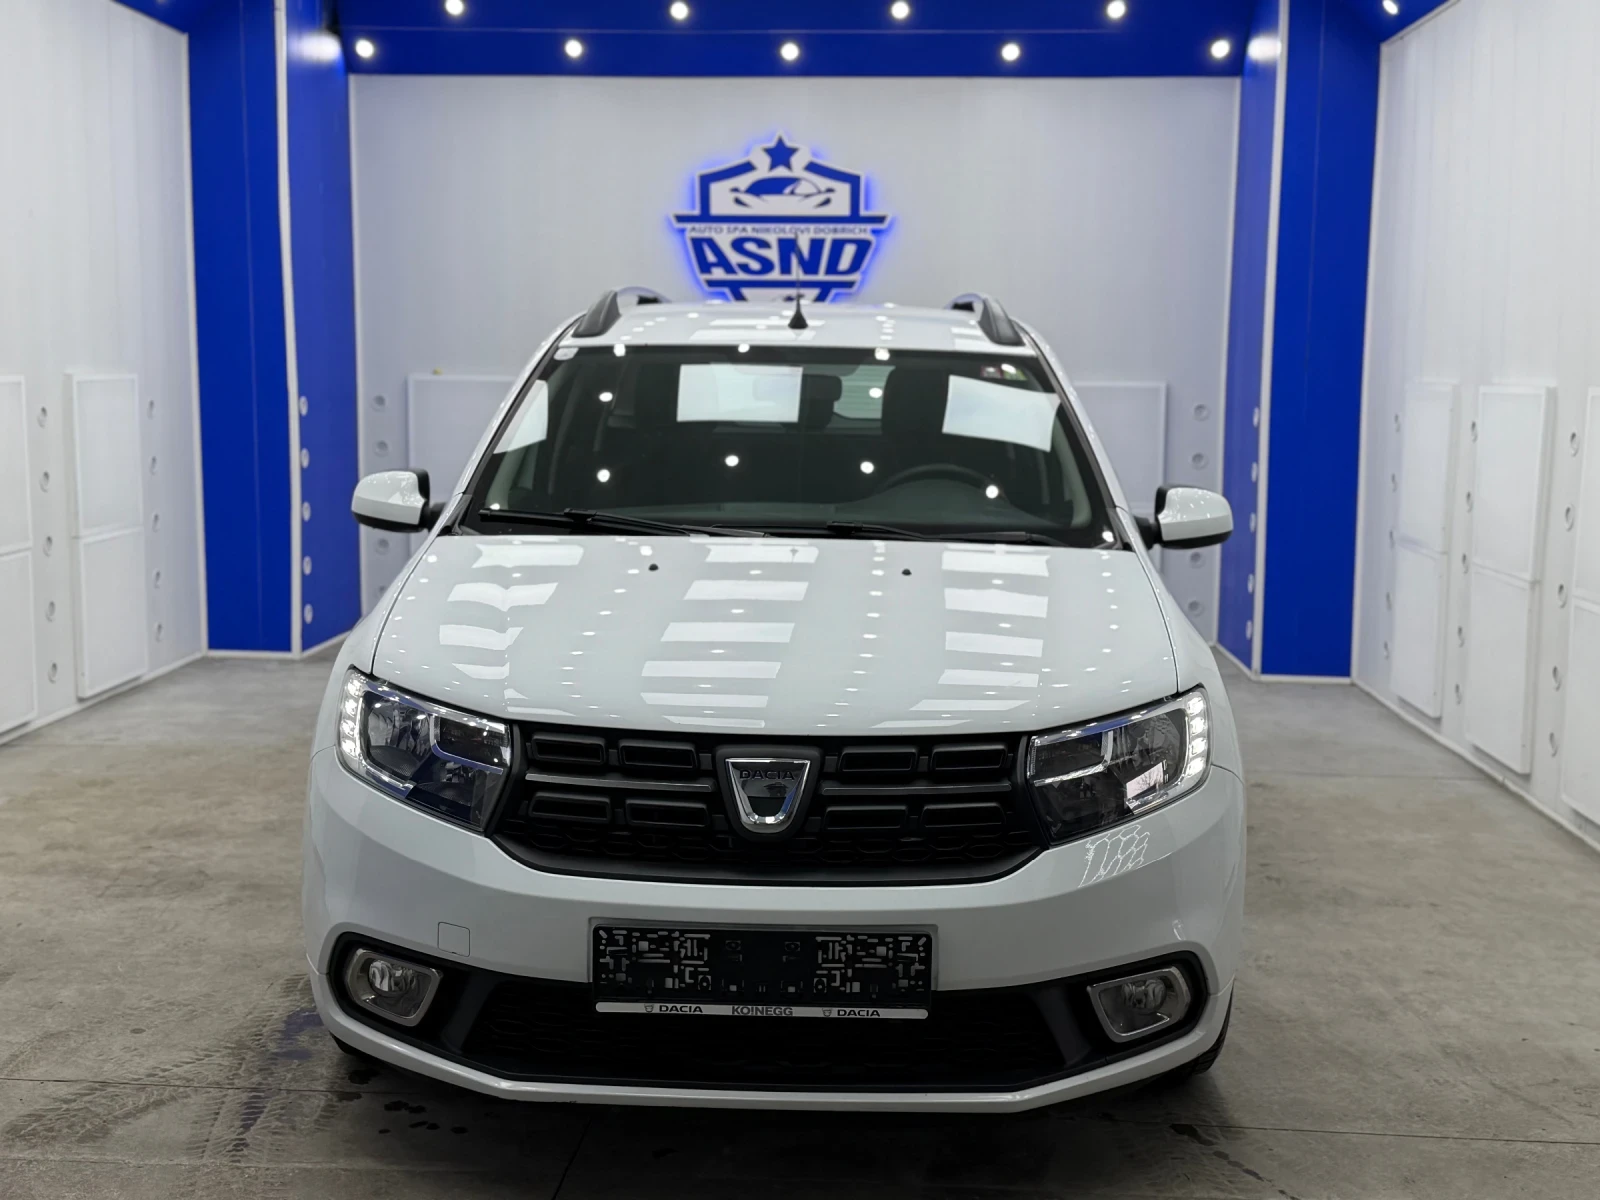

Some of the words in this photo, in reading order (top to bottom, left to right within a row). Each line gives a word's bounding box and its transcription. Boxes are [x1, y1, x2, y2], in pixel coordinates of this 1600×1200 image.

[689, 226, 724, 235] AUTO
[726, 226, 748, 235] SPA
[690, 237, 872, 276] ASND
[740, 769, 794, 780] DACIA
[659, 1004, 703, 1013] DACIA
[837, 1008, 880, 1017] DACIA
